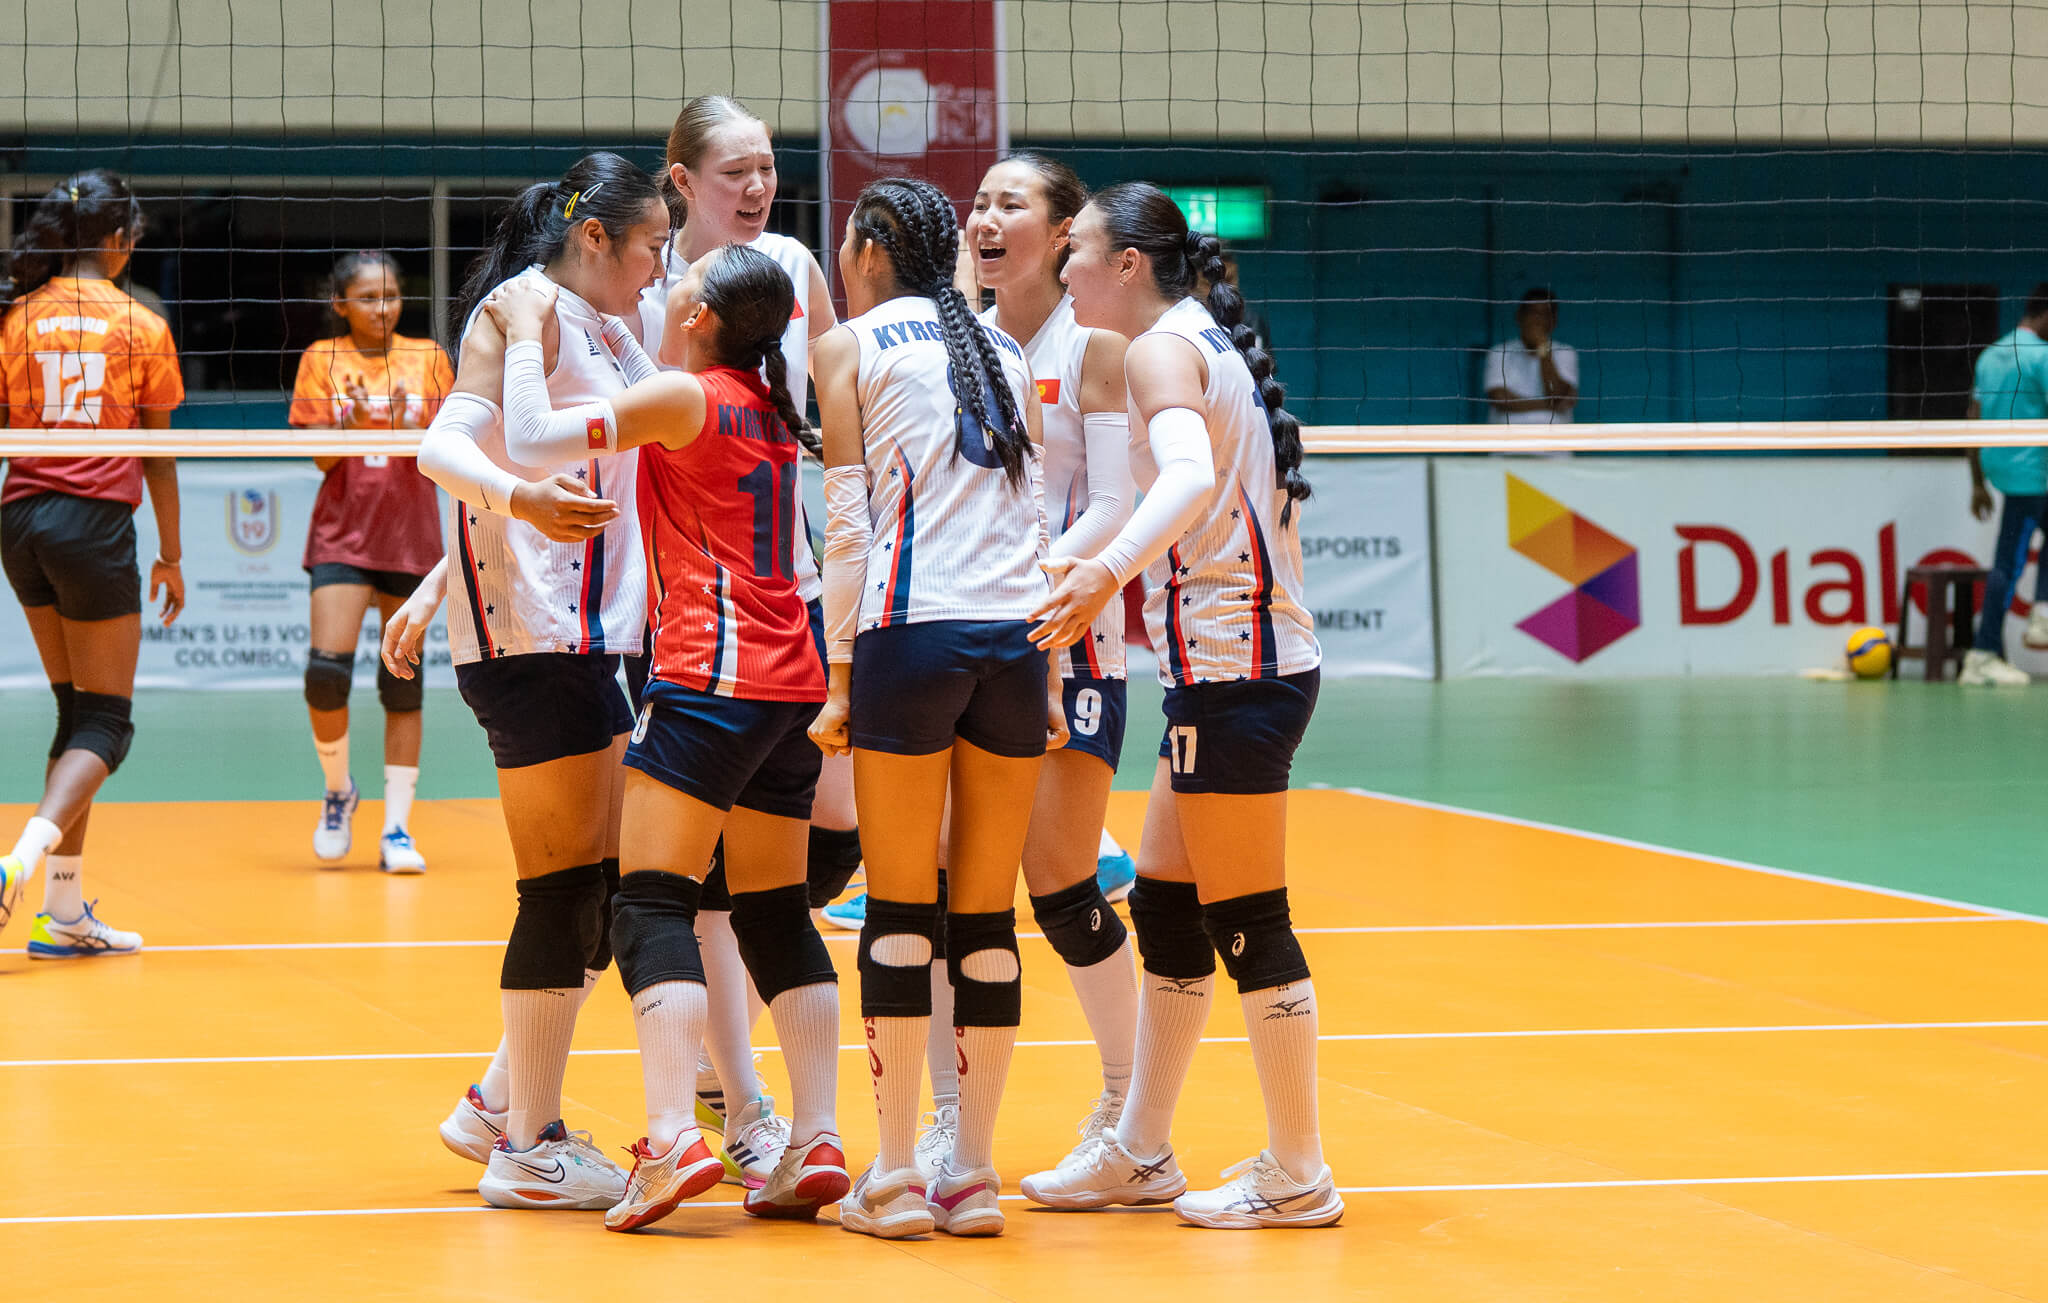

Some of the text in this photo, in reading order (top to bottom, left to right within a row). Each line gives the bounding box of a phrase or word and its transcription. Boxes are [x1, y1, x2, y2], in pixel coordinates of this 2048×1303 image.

[872, 320, 1022, 361] KYRGTAN
[34, 351, 106, 424] 12
[1301, 536, 1402, 558] SPORTS
[1315, 609, 1386, 631] MENT
[1074, 688, 1102, 735] 9
[1169, 725, 1197, 774] 17
